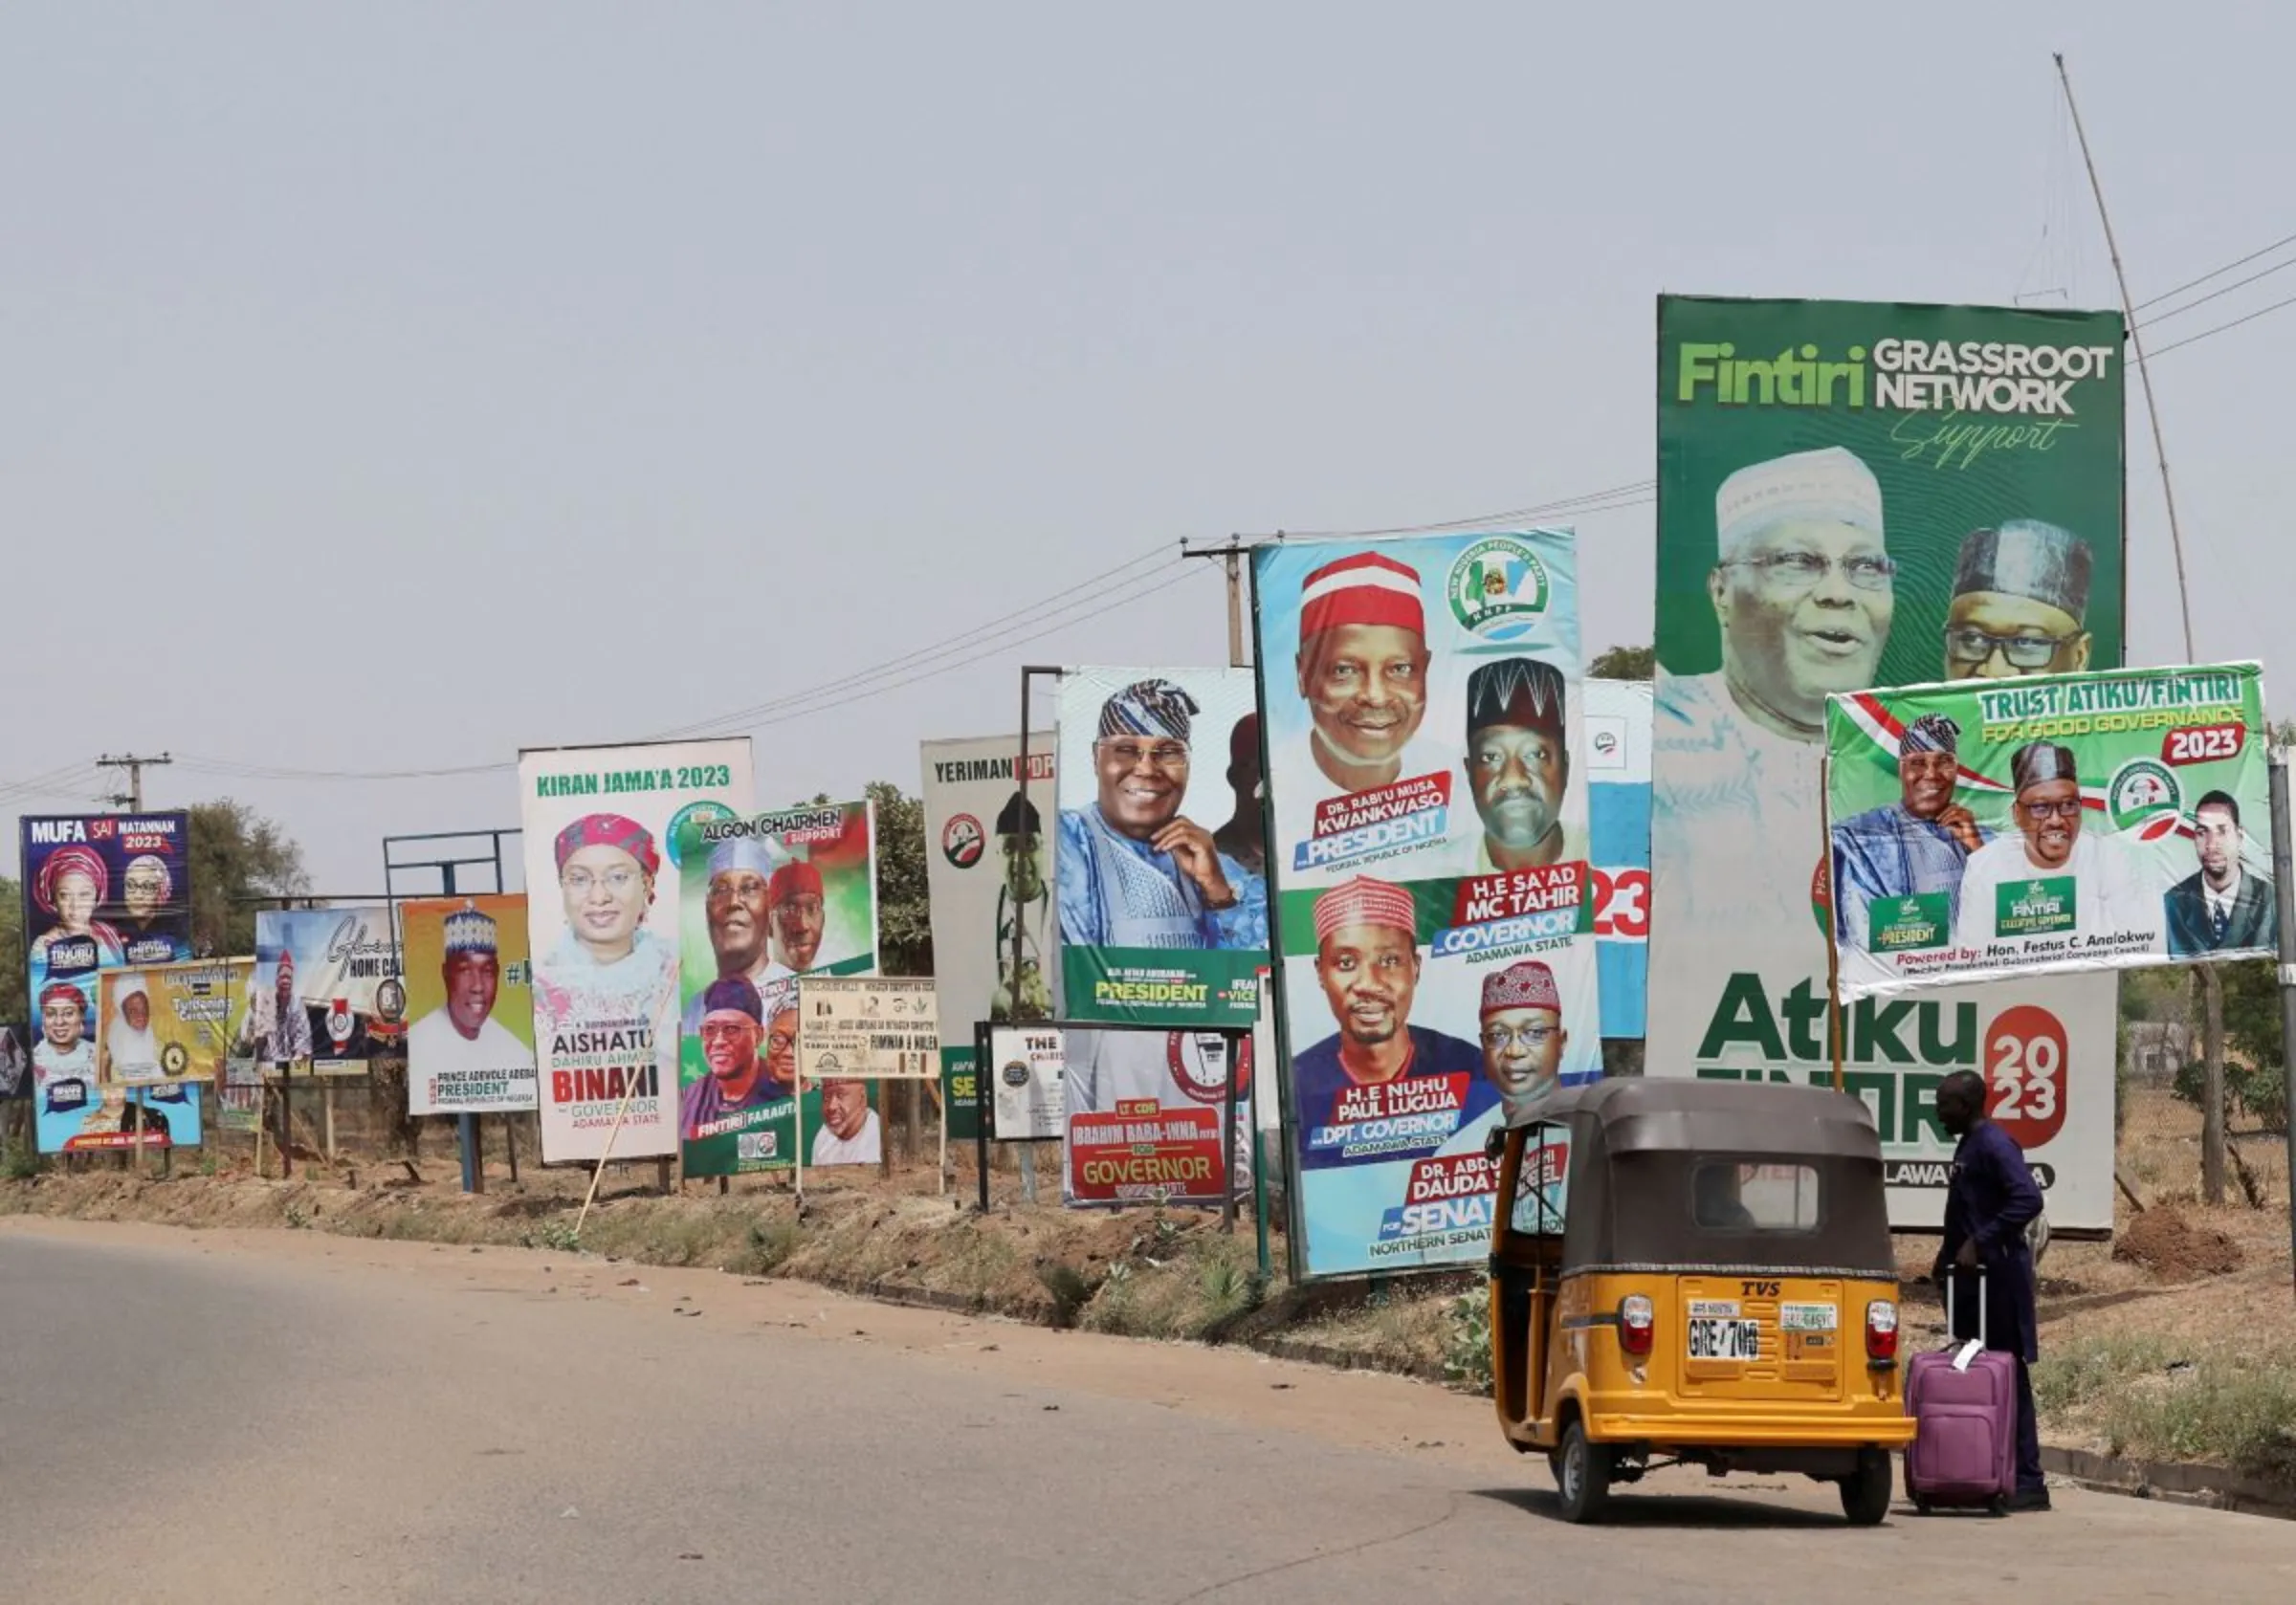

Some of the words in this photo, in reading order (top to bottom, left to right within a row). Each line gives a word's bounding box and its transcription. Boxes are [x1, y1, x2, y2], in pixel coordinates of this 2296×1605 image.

[1679, 342, 1866, 407] Fintiri
[1873, 338, 2114, 380] GRASSROOT
[1875, 373, 2075, 415] NETWORK
[1889, 396, 2080, 470] Support
[1980, 686, 2061, 720] TRUST
[1983, 722, 2023, 742] FOR
[2028, 718, 2091, 738] GOOD
[2094, 708, 2245, 733] GOVERNANCE
[2172, 727, 2239, 759] 2023
[537, 773, 598, 797] KIRAN
[603, 768, 673, 793] JAMA'A
[676, 764, 730, 788] 2023
[935, 758, 1013, 782] YERIMAN
[1327, 802, 1349, 816] DR.
[1351, 790, 1394, 810] RABI'U
[1397, 780, 1437, 798] MUSA
[702, 821, 757, 841] ALGON
[761, 809, 842, 834] CHAIRMEN
[1317, 792, 1444, 835] KWANKWASO
[32, 821, 86, 844] MUFA
[92, 820, 112, 839] SAI
[125, 836, 162, 848] 2023
[791, 828, 843, 844] SUPPORT
[1308, 810, 1441, 866] PRESIDENT
[1472, 877, 1508, 900] H.E
[1512, 867, 1577, 892] SA'AD
[1467, 897, 1505, 921] MC
[1510, 885, 1579, 913] TAHIR
[1444, 909, 1576, 953] GOVERNOR
[1466, 944, 1534, 965] ADAMAWA
[1535, 935, 1574, 952] STATE
[1896, 949, 1956, 965] Powered
[1960, 947, 1981, 962] by:
[1986, 943, 2020, 956] Hon.
[2023, 939, 2066, 954] Festus
[2069, 936, 2083, 949] C.
[350, 957, 380, 978] HOME
[382, 957, 406, 978] CAL
[1095, 981, 1208, 1001] PRESIDENT
[1227, 990, 1256, 1001] VICE
[1696, 973, 1977, 1065] Atiku
[552, 1028, 653, 1055] AISHATU
[1026, 1036, 1057, 1050] THE
[551, 1055, 603, 1068] DAHIRU
[1993, 1034, 2061, 1078] 20
[437, 1070, 468, 1082] PRINCE
[437, 1081, 509, 1096] PRESIDENT
[552, 1065, 658, 1103] BINANI
[1346, 1086, 1381, 1103] H.E
[1387, 1076, 1448, 1096] NUHU
[1338, 1102, 1384, 1122] PAUL
[1388, 1092, 1459, 1114] LUGUJA
[1992, 1077, 2058, 1120] 23
[633, 1112, 660, 1125] STATE
[697, 1114, 743, 1137] FINTIRI
[1361, 1113, 1456, 1139] GOVERNOR
[1072, 1125, 1124, 1145] IBRAHIM
[1083, 1156, 1212, 1184] GOVERNOR
[1422, 1163, 1449, 1179] DR.
[1454, 1154, 1504, 1176] ABDU
[1413, 1175, 1489, 1200] DAUDA
[1369, 1238, 1446, 1257] NORTHERN
[1741, 1282, 1781, 1296] TVS
